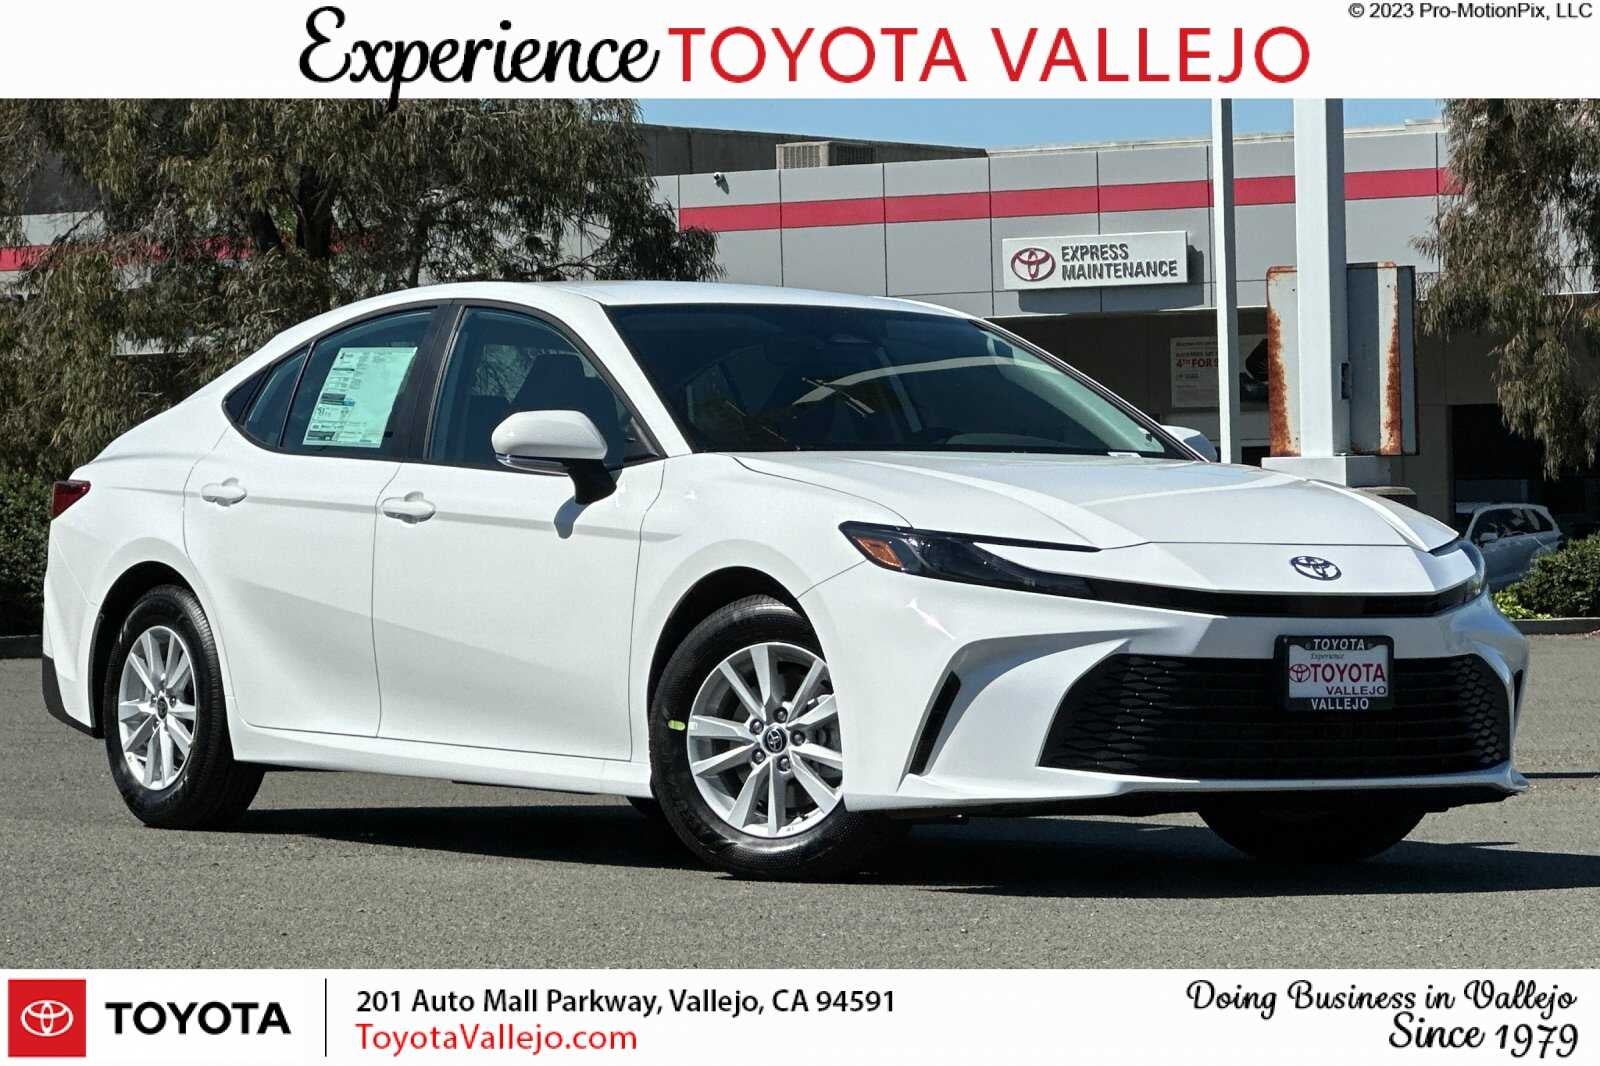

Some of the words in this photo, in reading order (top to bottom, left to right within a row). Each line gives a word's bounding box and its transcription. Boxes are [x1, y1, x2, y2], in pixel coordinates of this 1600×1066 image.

[1061, 243, 1129, 262] EXPRESS
[1061, 260, 1178, 281] MAINTENANCE
[1192, 358, 1213, 368] FOR
[1313, 639, 1365, 650] TOYOTA
[1310, 663, 1386, 683] TOYOTA
[1326, 685, 1387, 696] VALLEJO
[1311, 698, 1369, 710] VALLEJO
